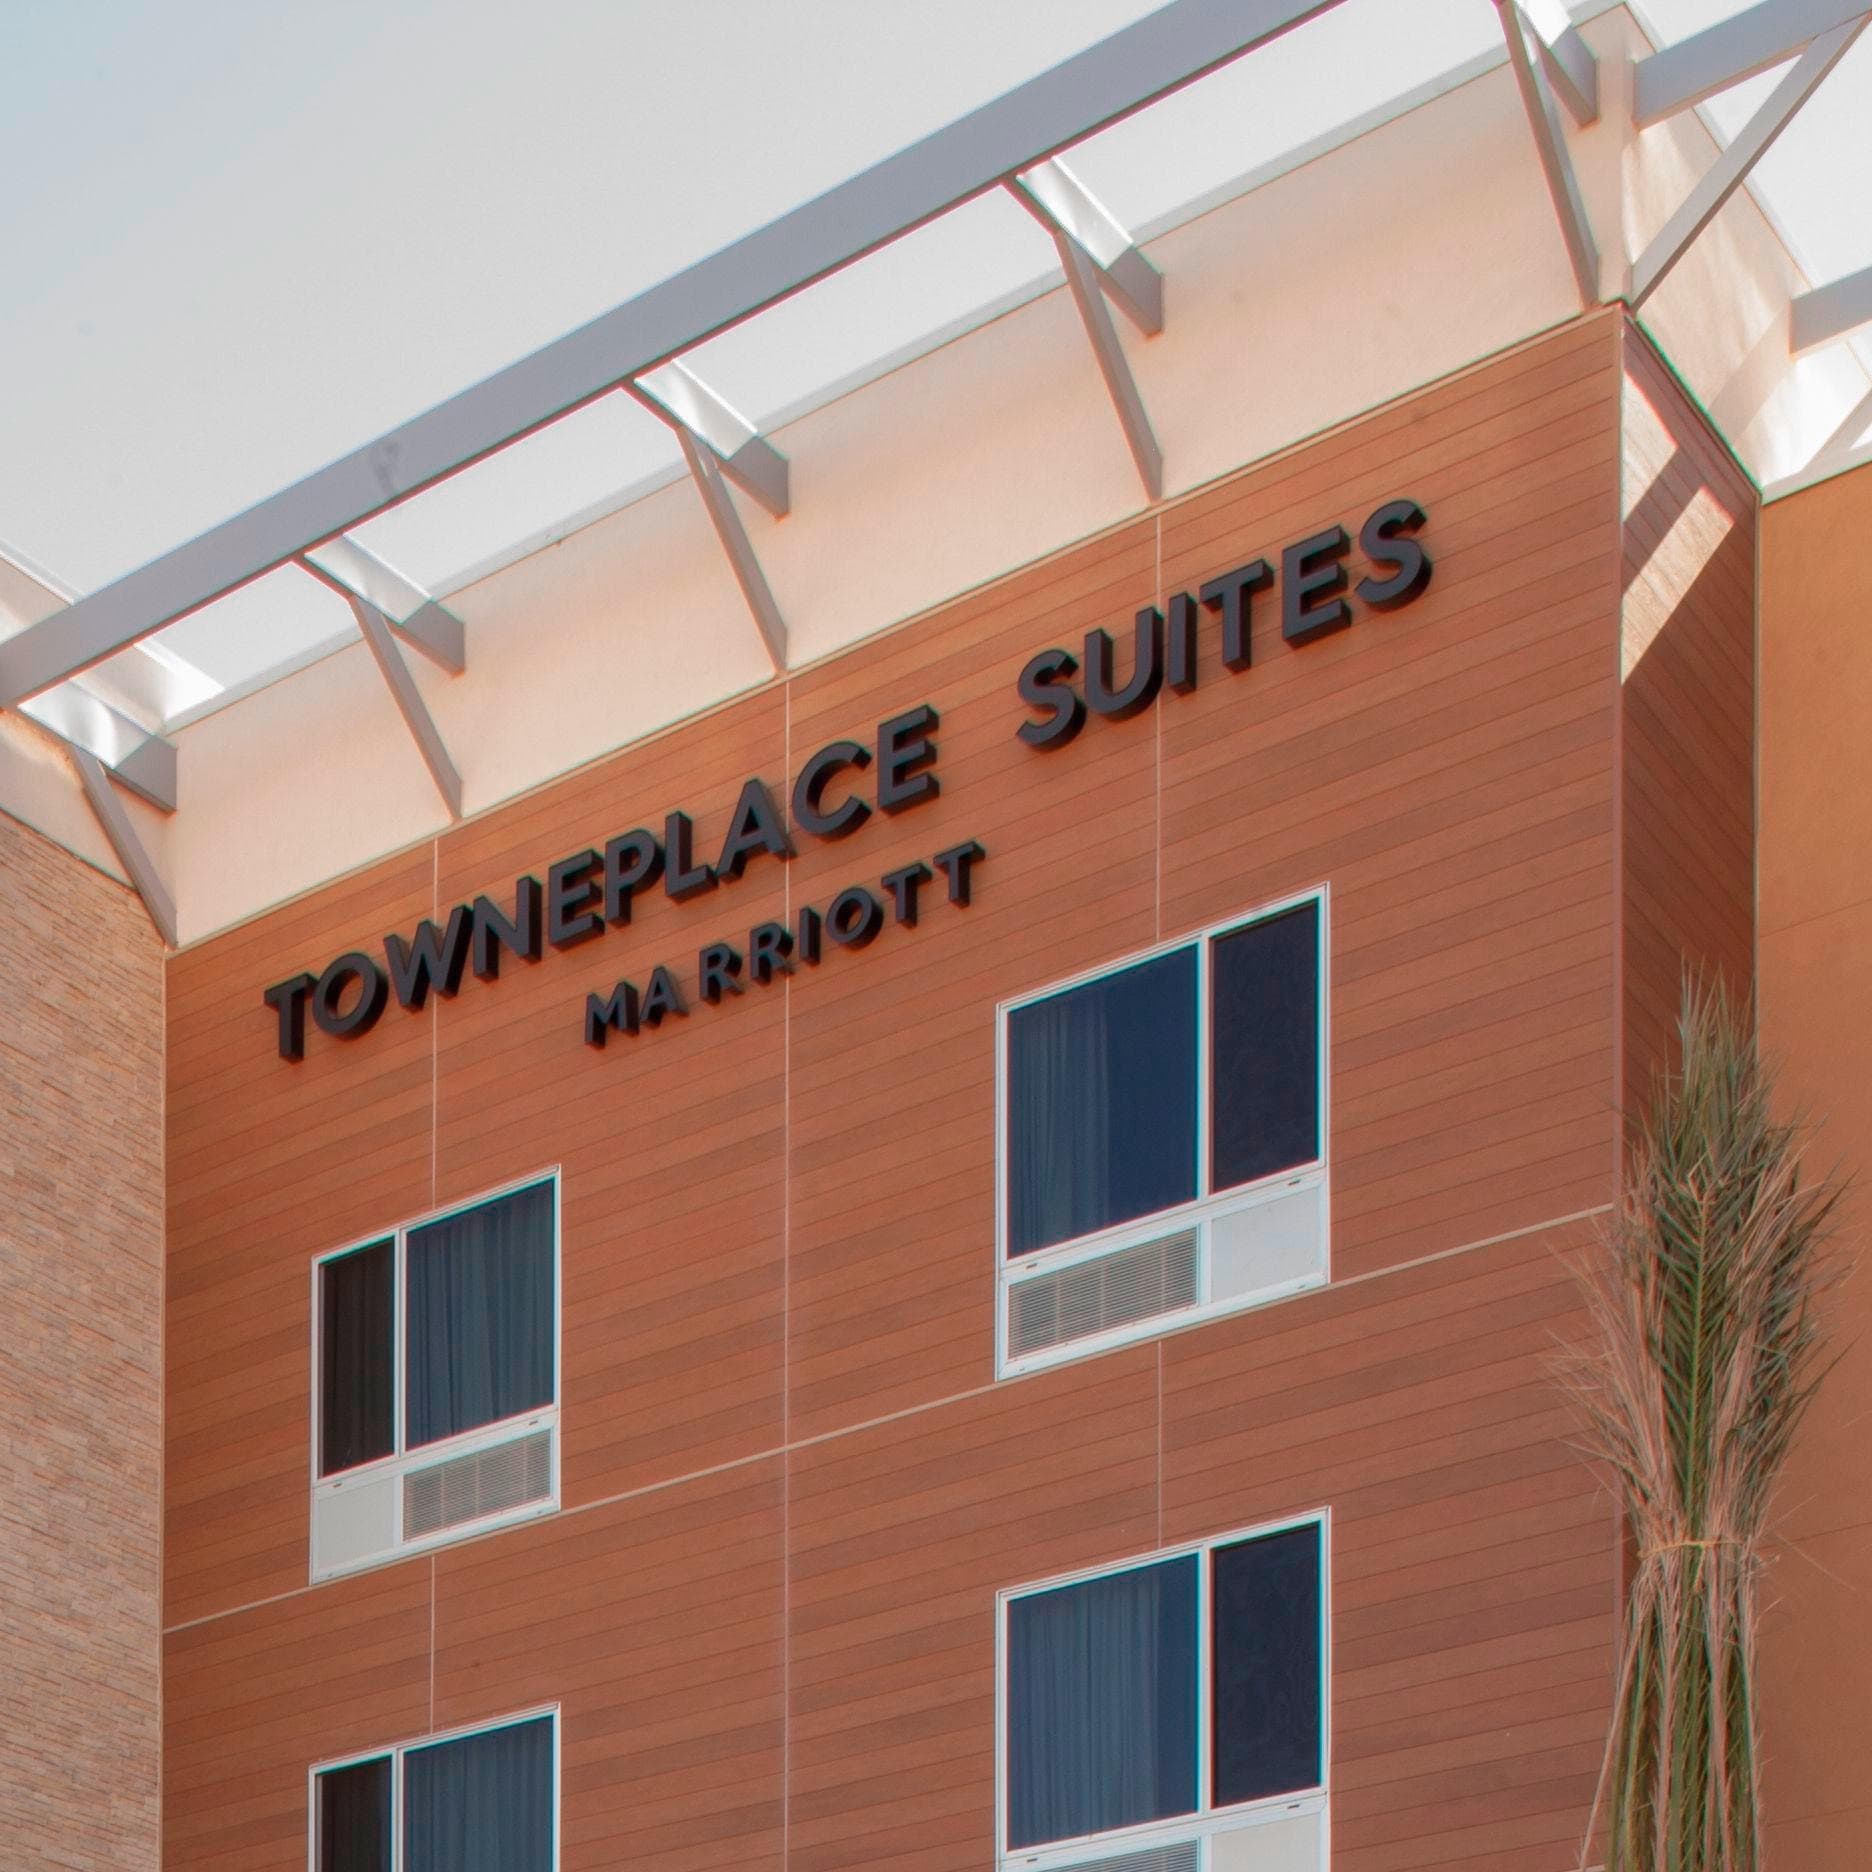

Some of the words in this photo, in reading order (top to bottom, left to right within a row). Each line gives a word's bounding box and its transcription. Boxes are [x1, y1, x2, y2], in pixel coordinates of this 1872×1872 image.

[265, 703, 940, 1062] TOWNEPLACE
[1016, 498, 1432, 749] SUITES
[584, 840, 986, 1047] MARRIOTT
